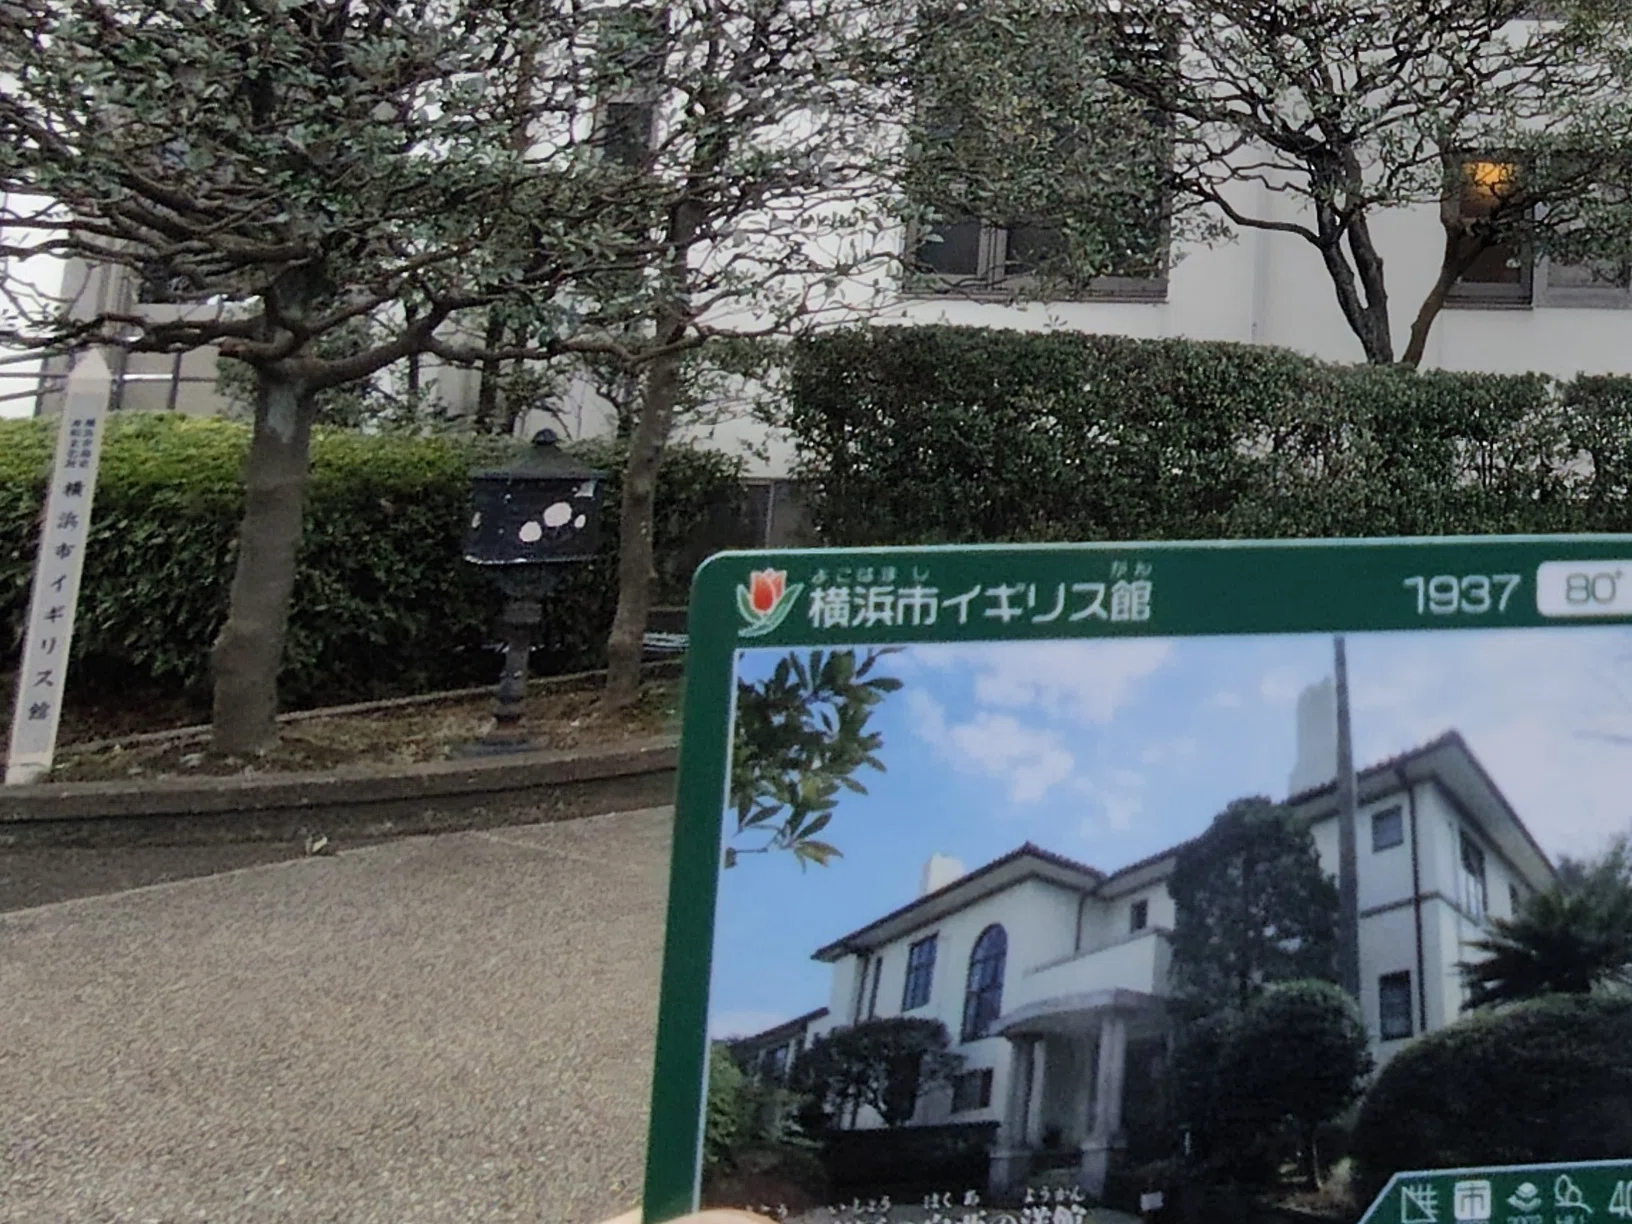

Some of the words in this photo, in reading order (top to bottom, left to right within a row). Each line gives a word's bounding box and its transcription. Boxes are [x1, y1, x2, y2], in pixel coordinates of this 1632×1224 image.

[28, 480, 86, 721] 横浜市イギリス館
[808, 579, 1153, 628] 横浜市イギリス館
[1403, 574, 1521, 615] 1937
